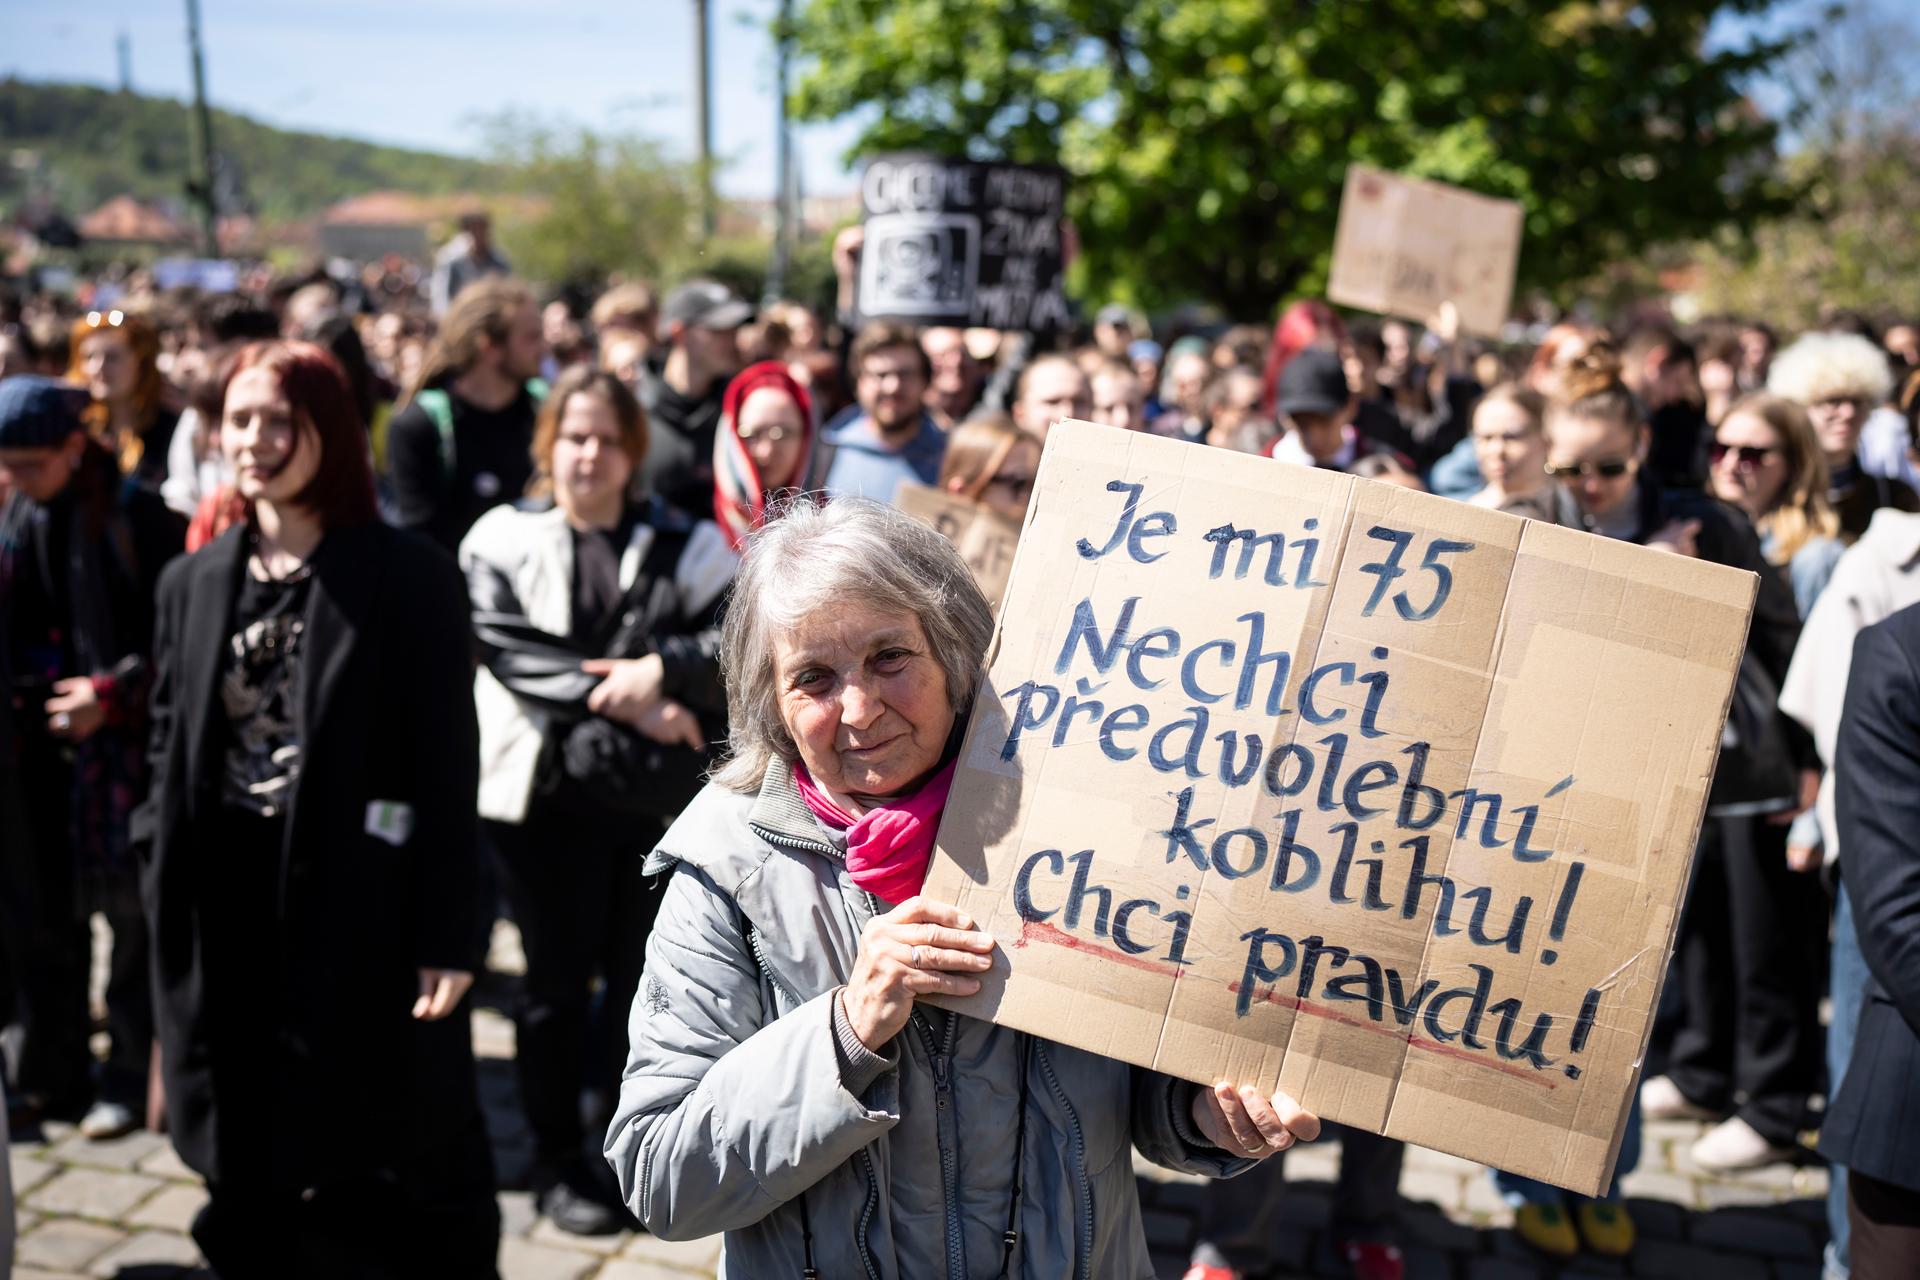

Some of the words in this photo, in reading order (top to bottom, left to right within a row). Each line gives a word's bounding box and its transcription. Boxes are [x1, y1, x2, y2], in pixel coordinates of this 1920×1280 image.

[1076, 480, 1178, 564] Je
[1203, 518, 1327, 589] mi
[1359, 525, 1476, 621] 75
[1054, 596, 1389, 739] Nechci
[1157, 787, 1585, 965] koblihu!
[1013, 849, 1195, 965] Chci
[1236, 927, 1602, 1080] pravdu!
